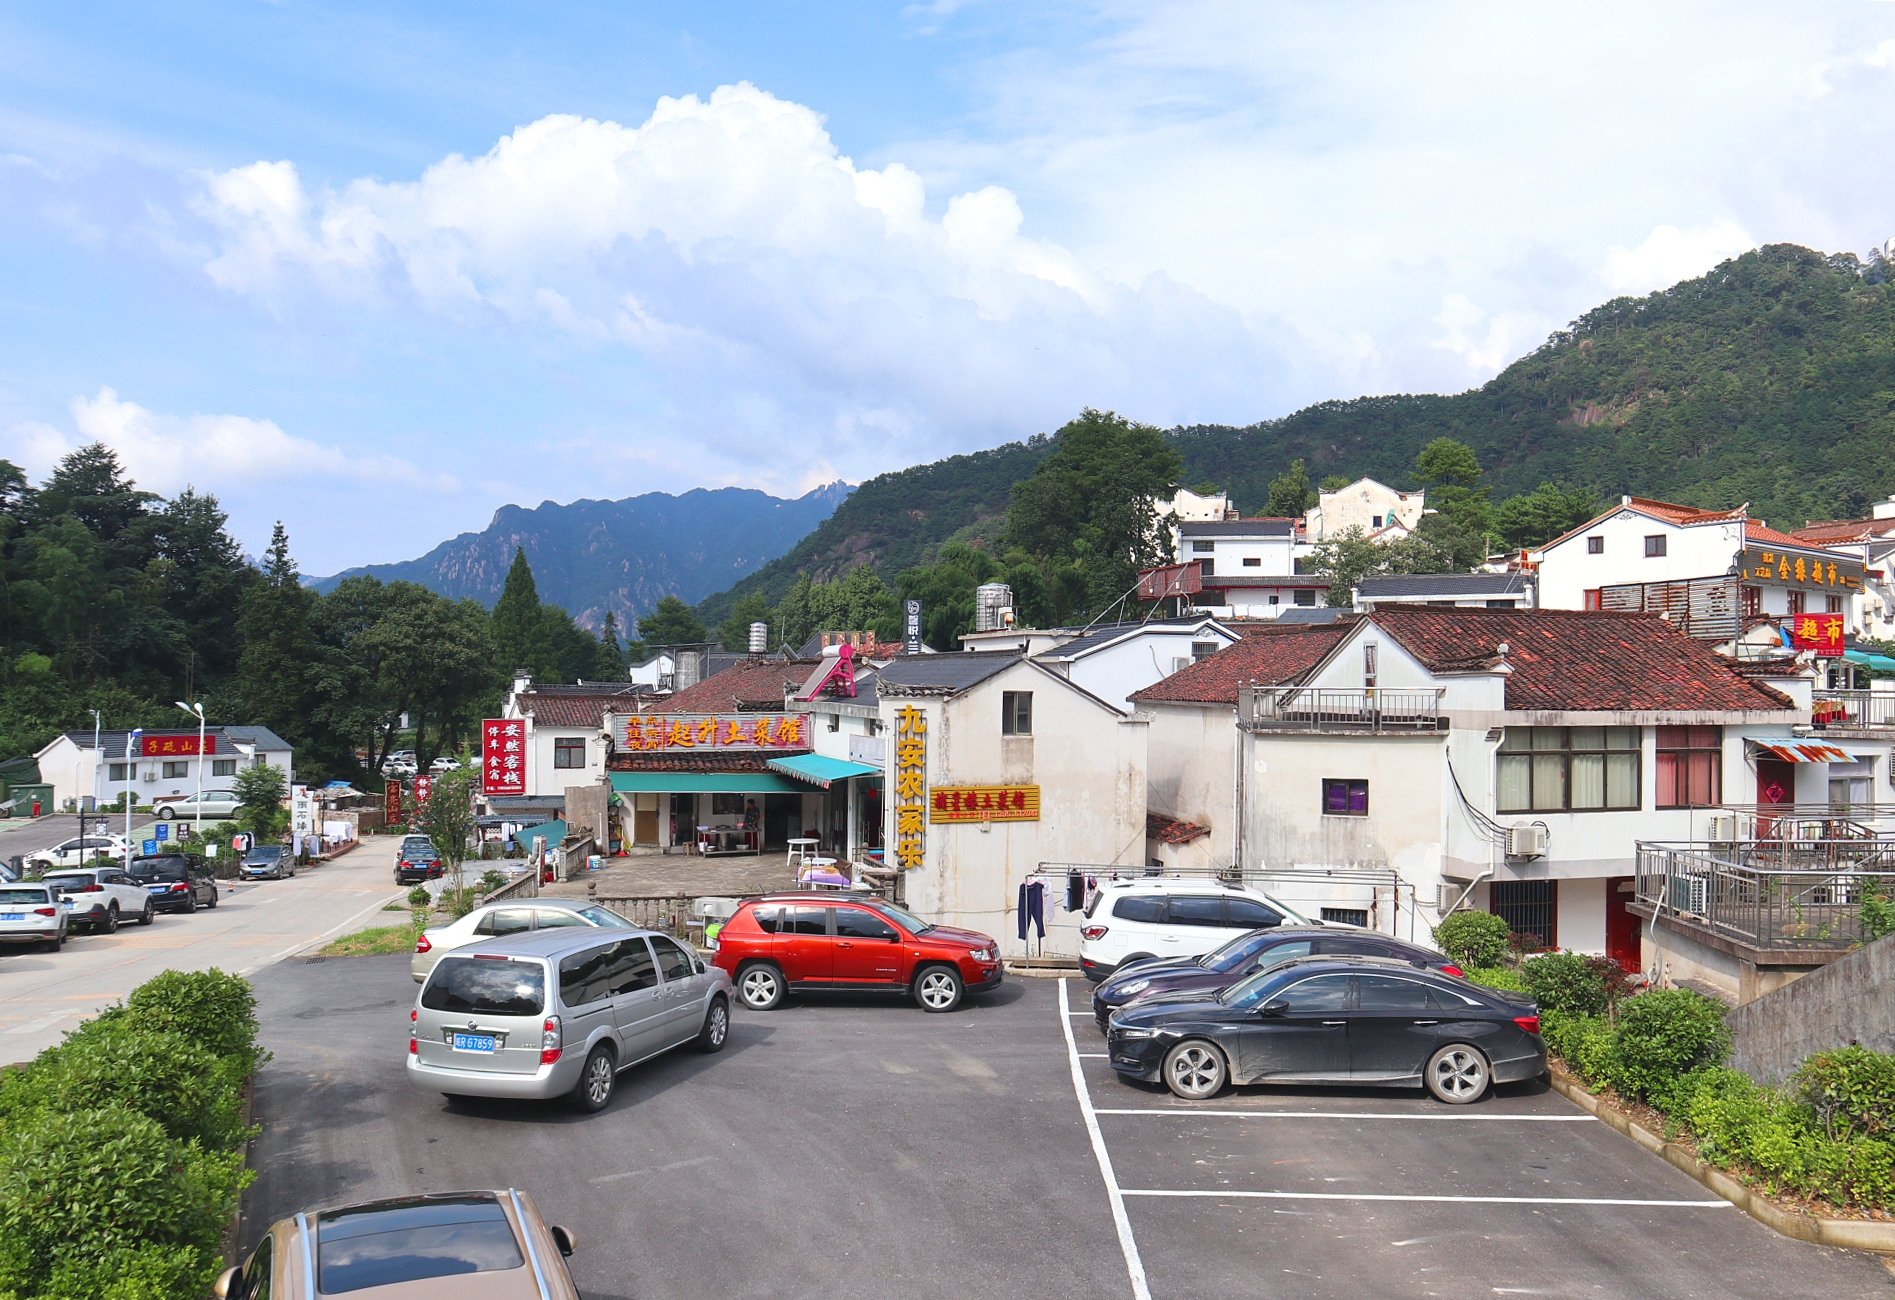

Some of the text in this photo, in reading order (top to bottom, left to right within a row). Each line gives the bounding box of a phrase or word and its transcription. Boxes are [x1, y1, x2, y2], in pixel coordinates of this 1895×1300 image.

[1797, 616, 1843, 646] 超市
[627, 716, 659, 726] 早点
[501, 724, 521, 785] 安然客栈
[896, 704, 926, 869] 九安农家乐
[977, 810, 993, 820] TEL
[467, 1038, 493, 1050] G7859
